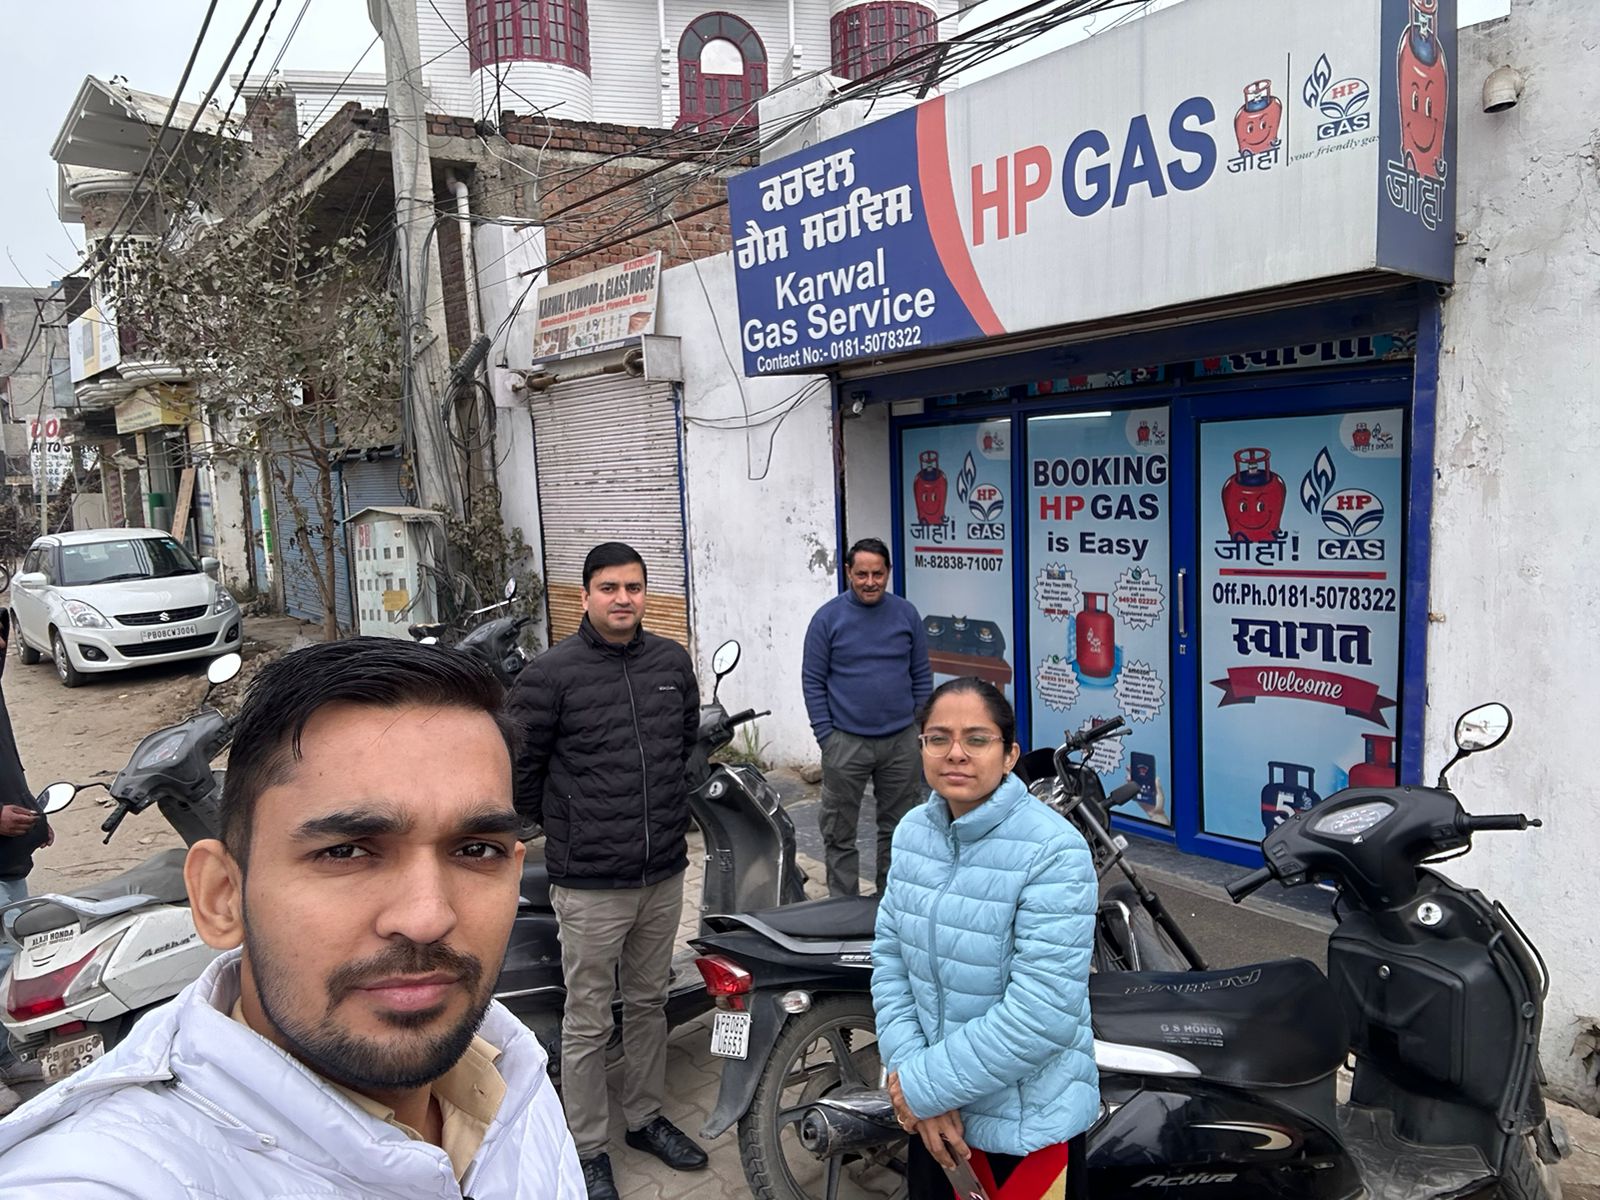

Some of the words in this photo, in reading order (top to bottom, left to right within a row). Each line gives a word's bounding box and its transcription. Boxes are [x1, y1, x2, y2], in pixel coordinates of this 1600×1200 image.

[1331, 82, 1360, 100] HP
[1318, 114, 1369, 139] GAS
[759, 148, 855, 212] ਕਰਵਲ
[972, 146, 1052, 247] HP
[1062, 97, 1217, 218] GAS
[736, 220, 789, 270] ਗੈਸ
[800, 187, 913, 250] ਸਰਵਿਸ
[605, 272, 629, 300] GLASS
[629, 265, 656, 294] HOUSE
[775, 247, 885, 310] Karwal
[743, 319, 798, 352] Gas
[808, 287, 935, 340] Service
[757, 352, 800, 372] Contact
[831, 326, 921, 359] 0181-5078322
[31, 442, 60, 453] ATO
[1034, 455, 1167, 486] BOOKING
[977, 489, 997, 500] HP
[1040, 496, 1085, 520] HP
[1091, 493, 1159, 520] GAS
[1337, 495, 1372, 510] HP
[969, 524, 1003, 539] GAS
[1048, 531, 1069, 552] is
[1080, 532, 1149, 561] Easy
[1319, 539, 1383, 560] GAS
[1231, 618, 1373, 665] स्वागत
[1257, 671, 1342, 698] Welcome
[50, 929, 74, 941] HONDA
[1183, 1025, 1223, 1036] HONDA
[46, 1051, 59, 1062] PB
[78, 1043, 92, 1054] DC
[1131, 1173, 1237, 1188] Activa
